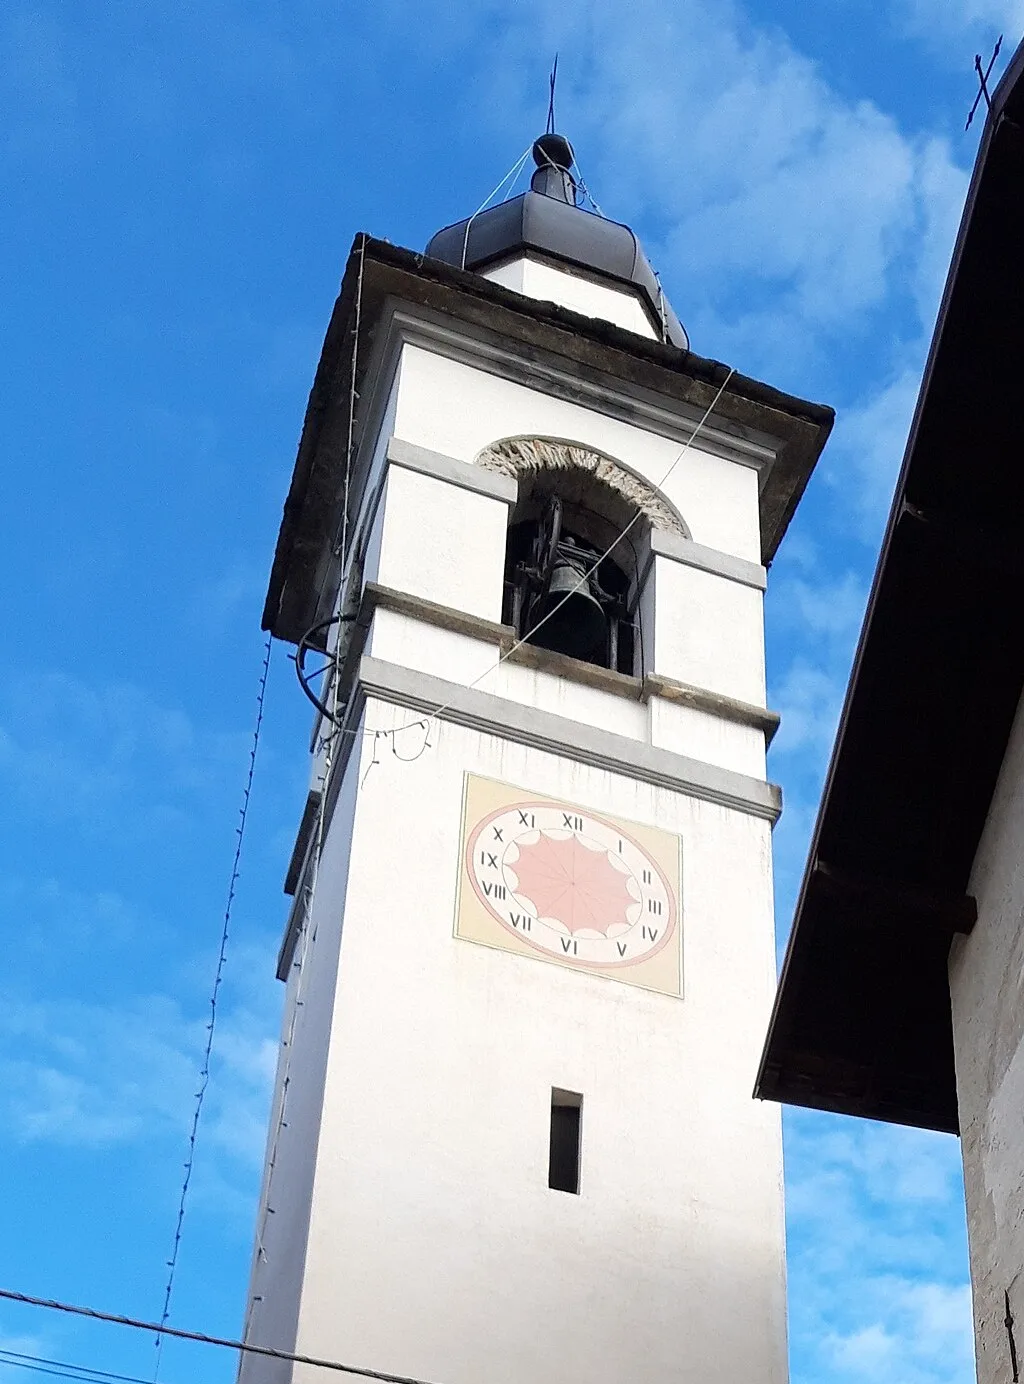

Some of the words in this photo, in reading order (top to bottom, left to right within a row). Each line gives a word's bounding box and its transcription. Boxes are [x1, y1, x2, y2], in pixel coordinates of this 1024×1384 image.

[519, 809, 534, 828] XI
[563, 813, 582, 831] XII
[494, 827, 503, 841] X
[481, 852, 497, 868] IX
[643, 870, 651, 885] II
[482, 881, 505, 900] VIII
[648, 900, 661, 915] III
[510, 913, 530, 930] VII
[642, 926, 657, 941] IV
[561, 938, 576, 954] VI
[617, 942, 626, 956] V
